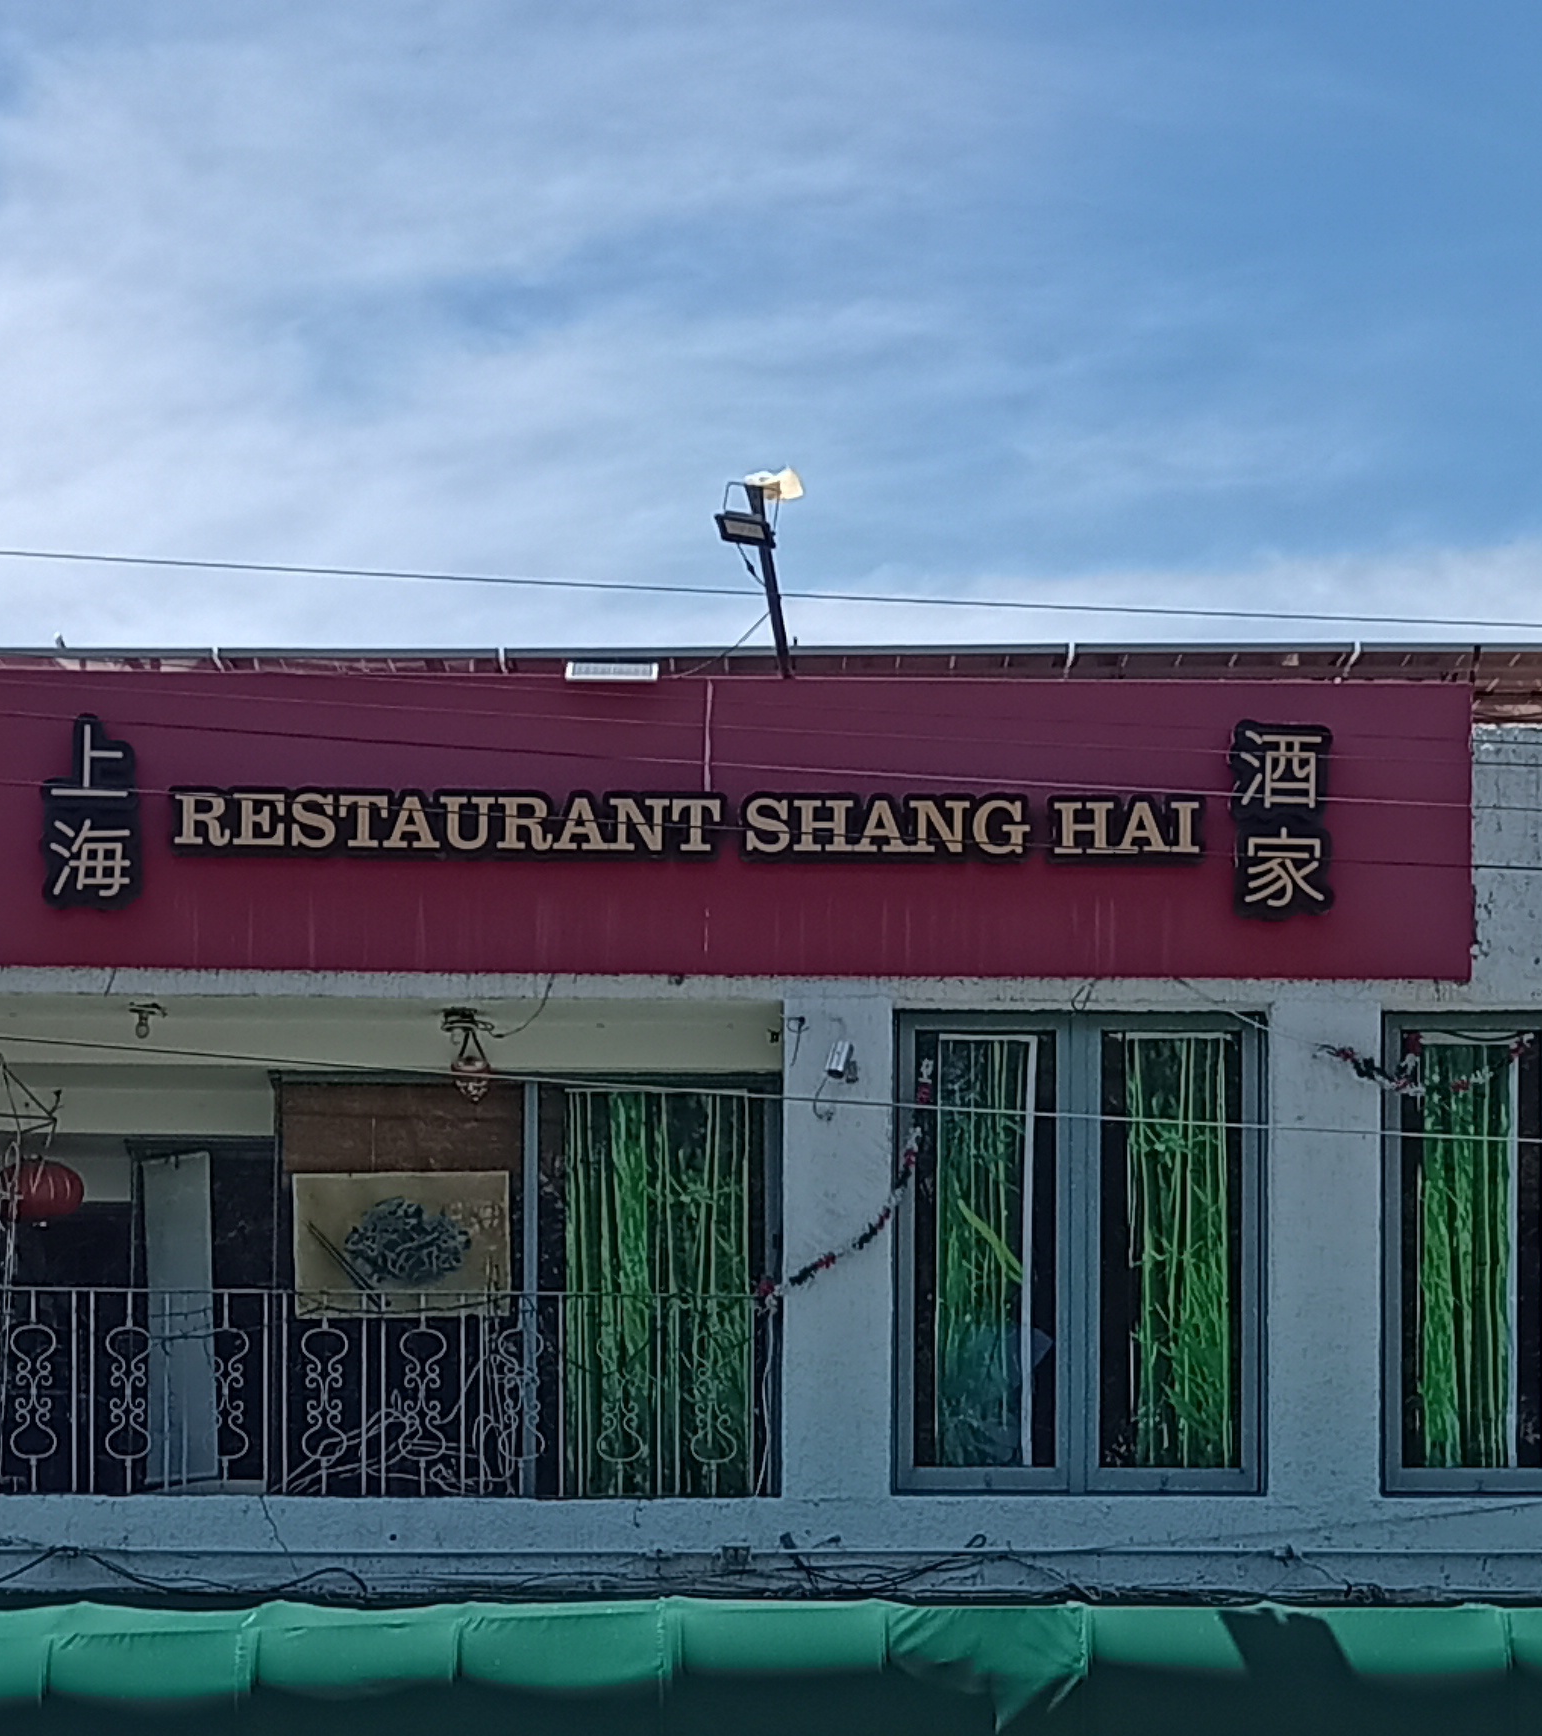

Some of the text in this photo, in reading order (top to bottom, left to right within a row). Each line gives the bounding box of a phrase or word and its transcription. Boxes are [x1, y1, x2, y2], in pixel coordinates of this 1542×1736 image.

[50, 723, 131, 898] 上海
[174, 793, 1201, 855] RESTAURANT SHANG HAI
[1239, 728, 1326, 908] 酒家
